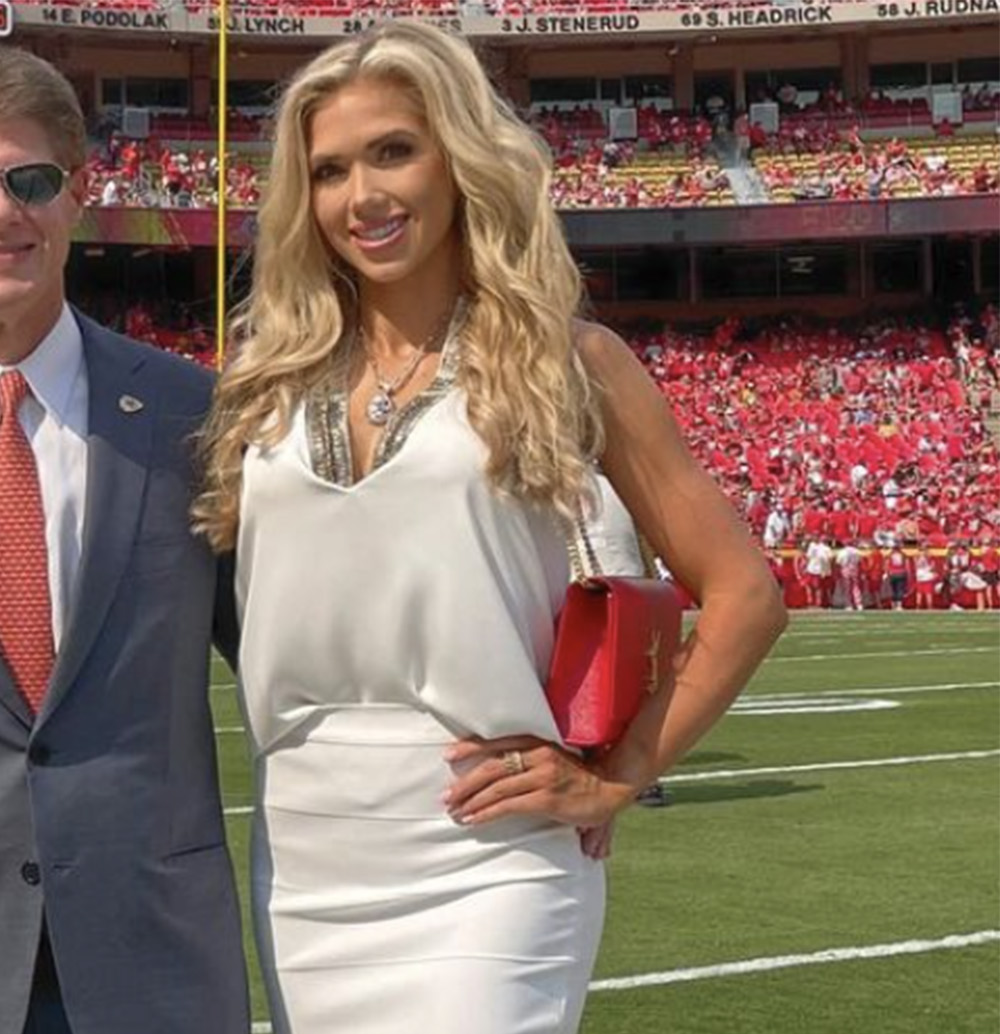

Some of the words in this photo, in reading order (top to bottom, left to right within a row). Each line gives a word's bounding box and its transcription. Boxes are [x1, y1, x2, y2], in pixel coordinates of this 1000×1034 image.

[681, 13, 701, 26] 69
[728, 6, 832, 26] HEADRICK
[878, 3, 899, 16] 58
[904, 2, 920, 15] J.
[42, 8, 57, 20] 14
[80, 9, 168, 29] PODOLAK
[244, 18, 304, 33] LYNCH
[501, 18, 512, 31] 3
[516, 18, 532, 32] J.
[536, 14, 640, 32] STENERUD
